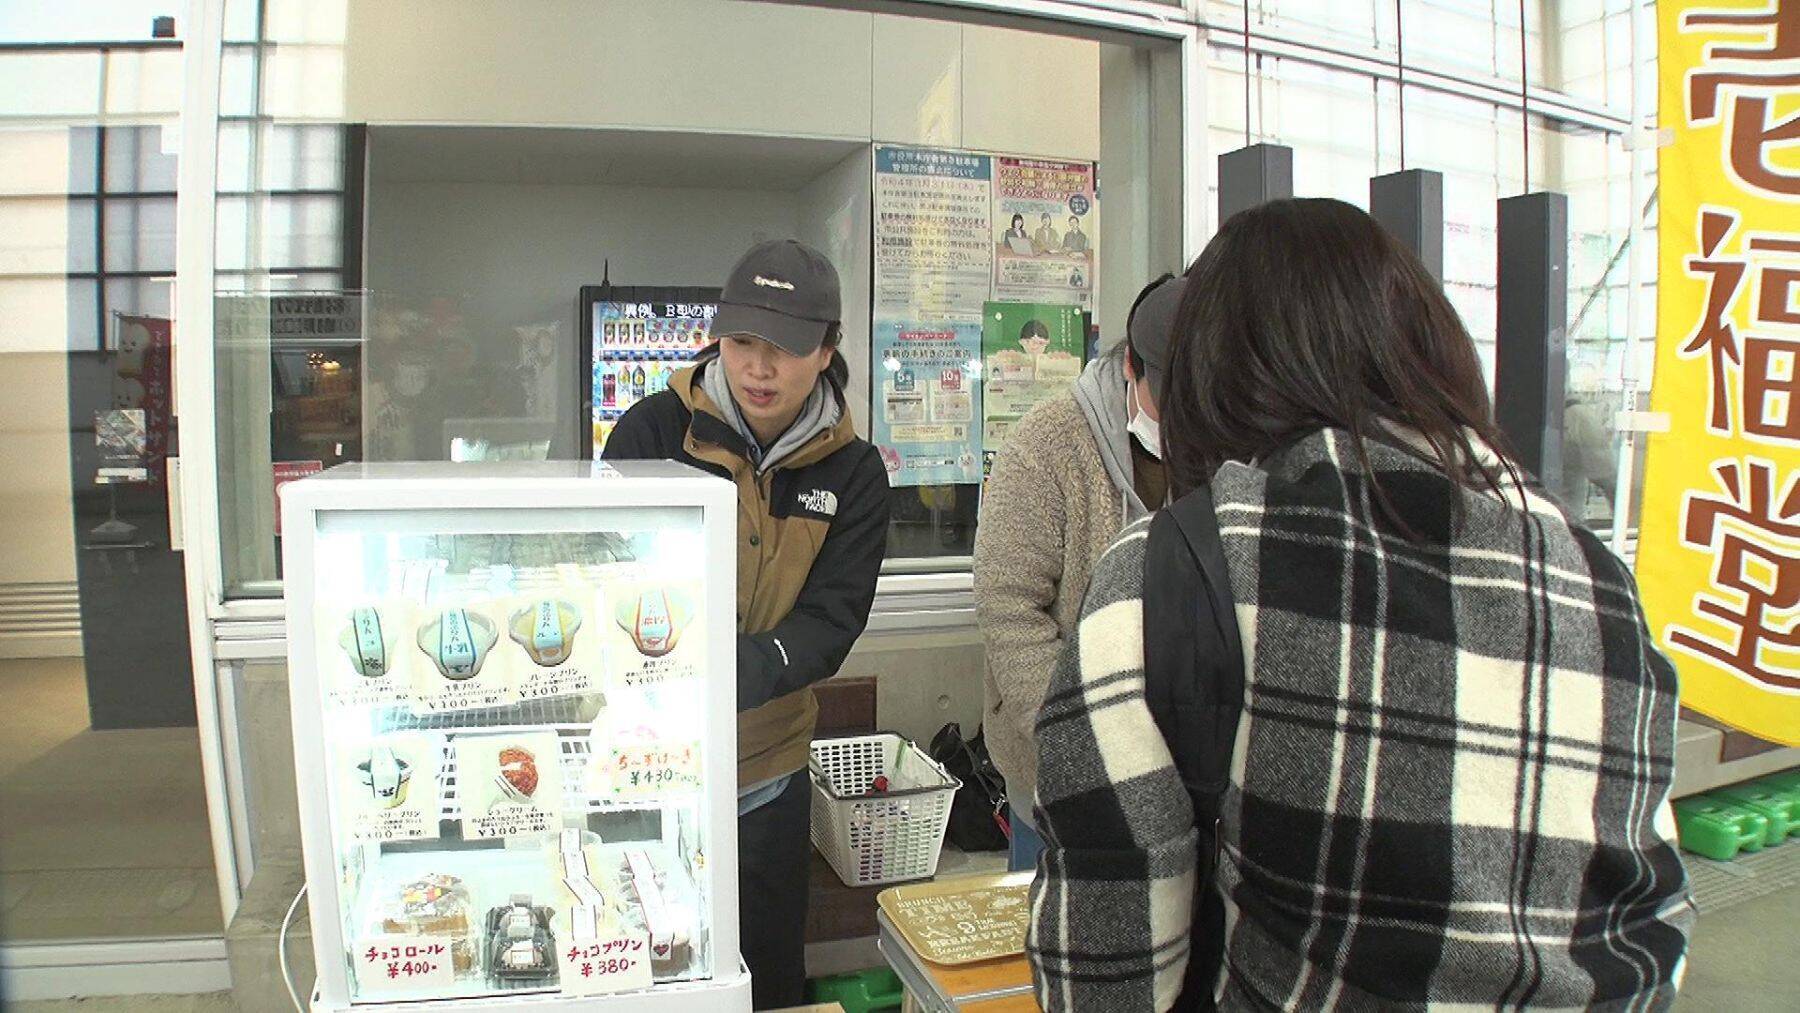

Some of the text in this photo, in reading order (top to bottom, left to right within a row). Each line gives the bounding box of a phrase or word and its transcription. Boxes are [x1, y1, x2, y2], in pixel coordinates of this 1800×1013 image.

[365, 944, 446, 962] チョコロール
[567, 939, 643, 961] チョコプリン
